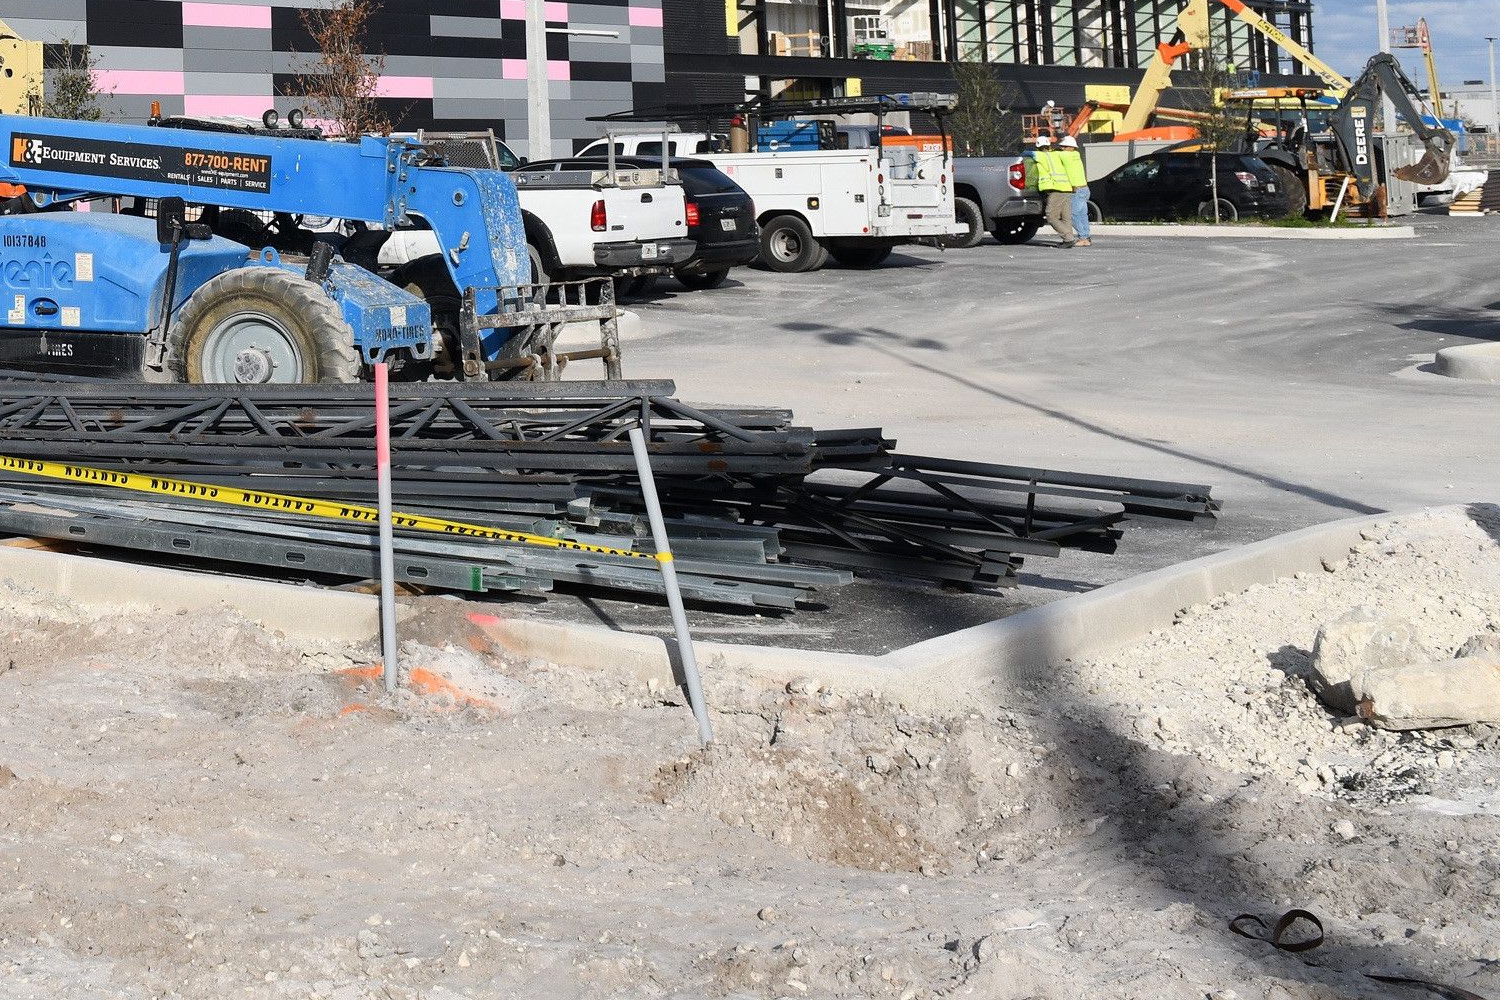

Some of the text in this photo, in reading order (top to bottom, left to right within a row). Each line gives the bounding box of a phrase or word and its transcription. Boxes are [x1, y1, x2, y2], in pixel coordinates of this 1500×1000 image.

[1258, 19, 1285, 42] ACTION
[1354, 118, 1368, 165] DEERE
[42, 146, 106, 165] EQUIPMENT
[185, 152, 268, 173] 877-700-RENT
[167, 172, 267, 189] RENTALS SALES PARTS SERVICE
[3, 235, 47, 248] 10137848
[64, 465, 129, 485] CAUTION
[150, 478, 219, 498] CAUTION
[242, 492, 315, 512] CAUTION
[340, 508, 418, 527] CATION
